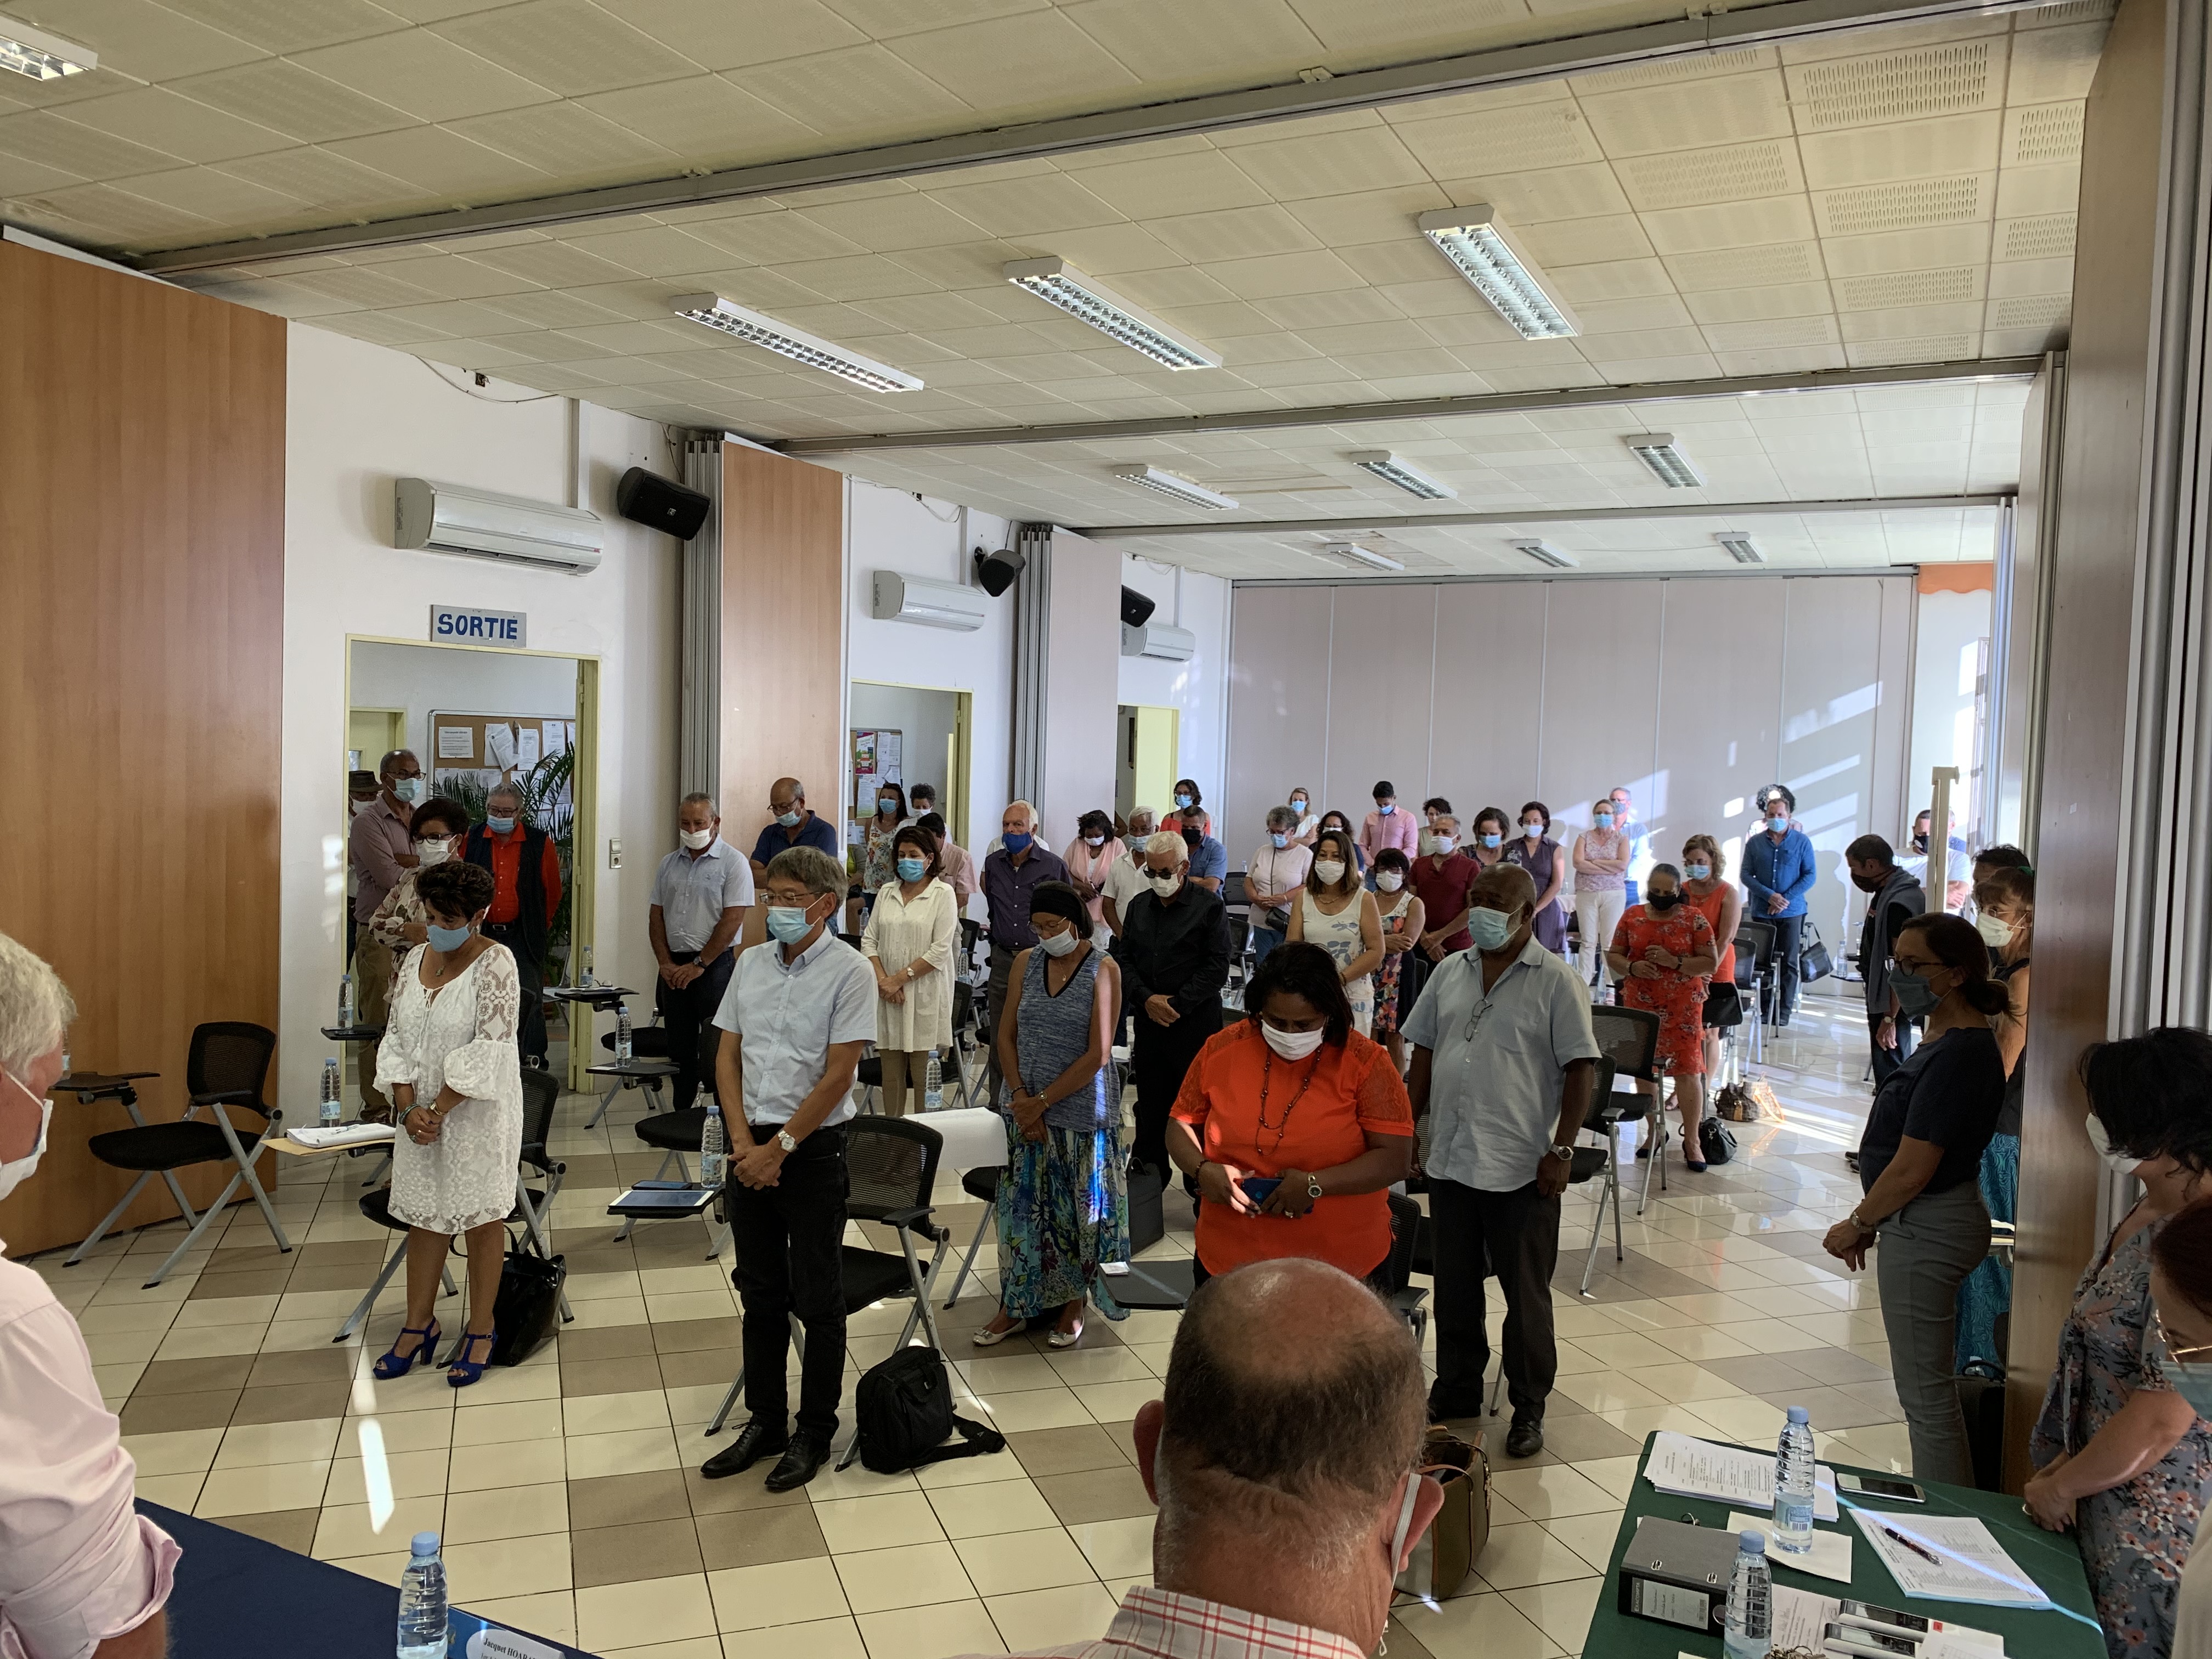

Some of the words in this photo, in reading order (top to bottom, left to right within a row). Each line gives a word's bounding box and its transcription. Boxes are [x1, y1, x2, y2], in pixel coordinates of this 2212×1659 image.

[437, 613, 518, 640] SORTIE
[483, 1638, 506, 1654] Jacquet
[507, 1647, 535, 1659] HOAR
